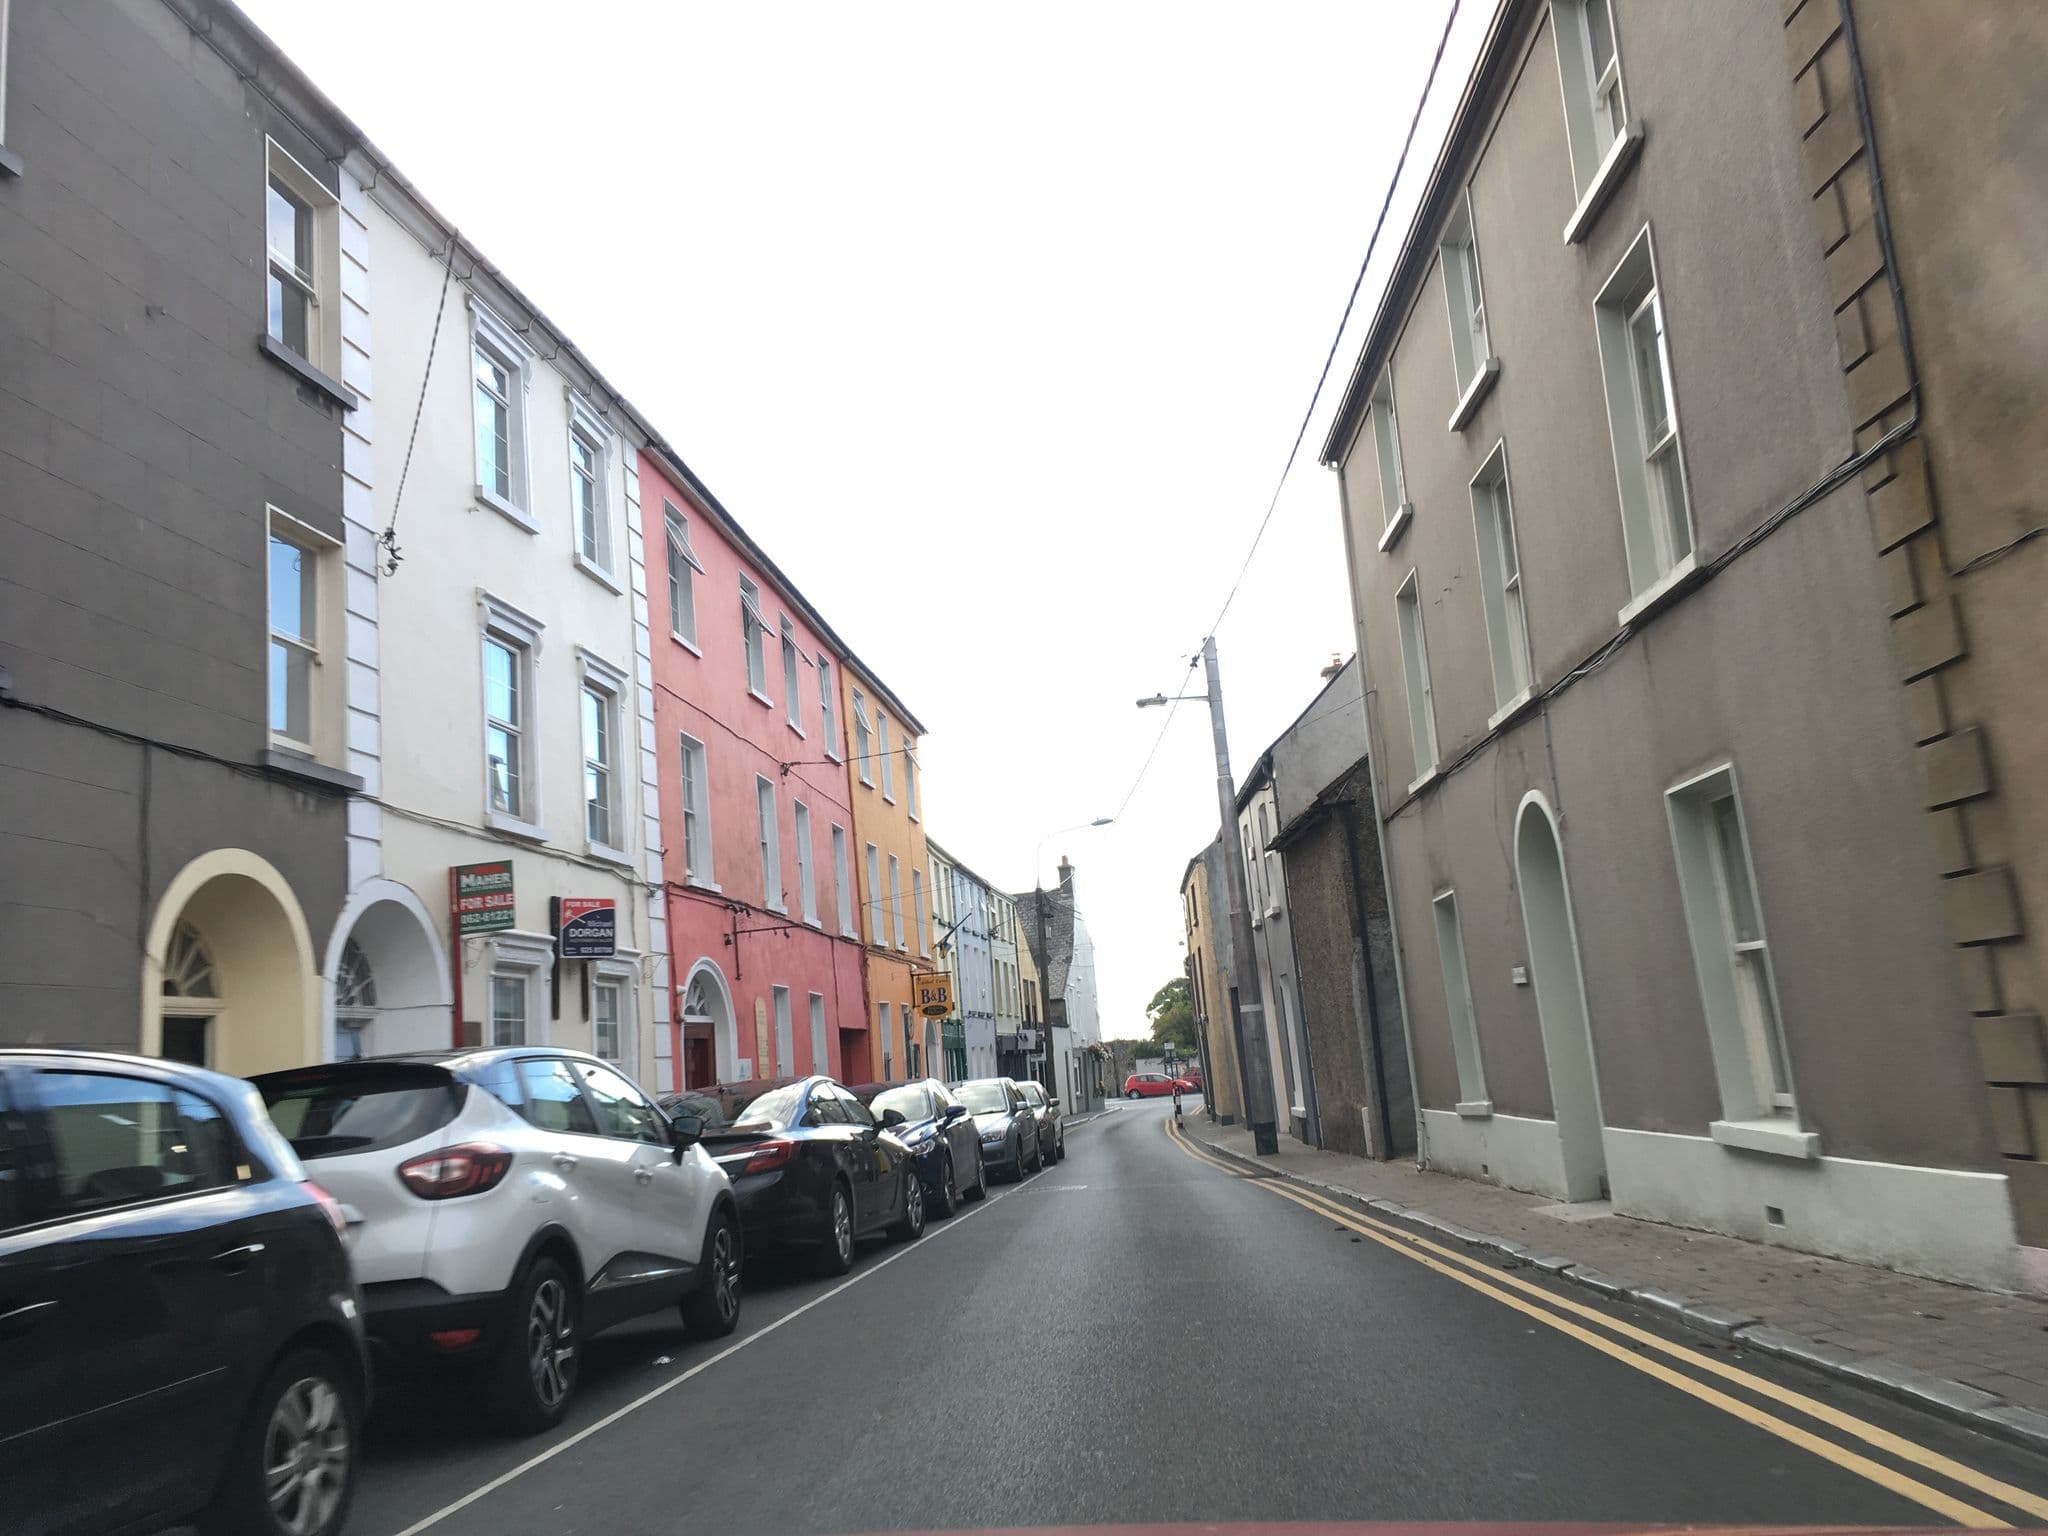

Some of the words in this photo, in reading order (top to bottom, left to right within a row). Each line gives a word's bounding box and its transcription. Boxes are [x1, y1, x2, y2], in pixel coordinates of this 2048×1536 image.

[461, 873, 512, 887] MAHER
[460, 897, 483, 910] FOR
[485, 893, 514, 907] SALE
[568, 928, 614, 938] DORGAN
[921, 988, 947, 1004] B&B
